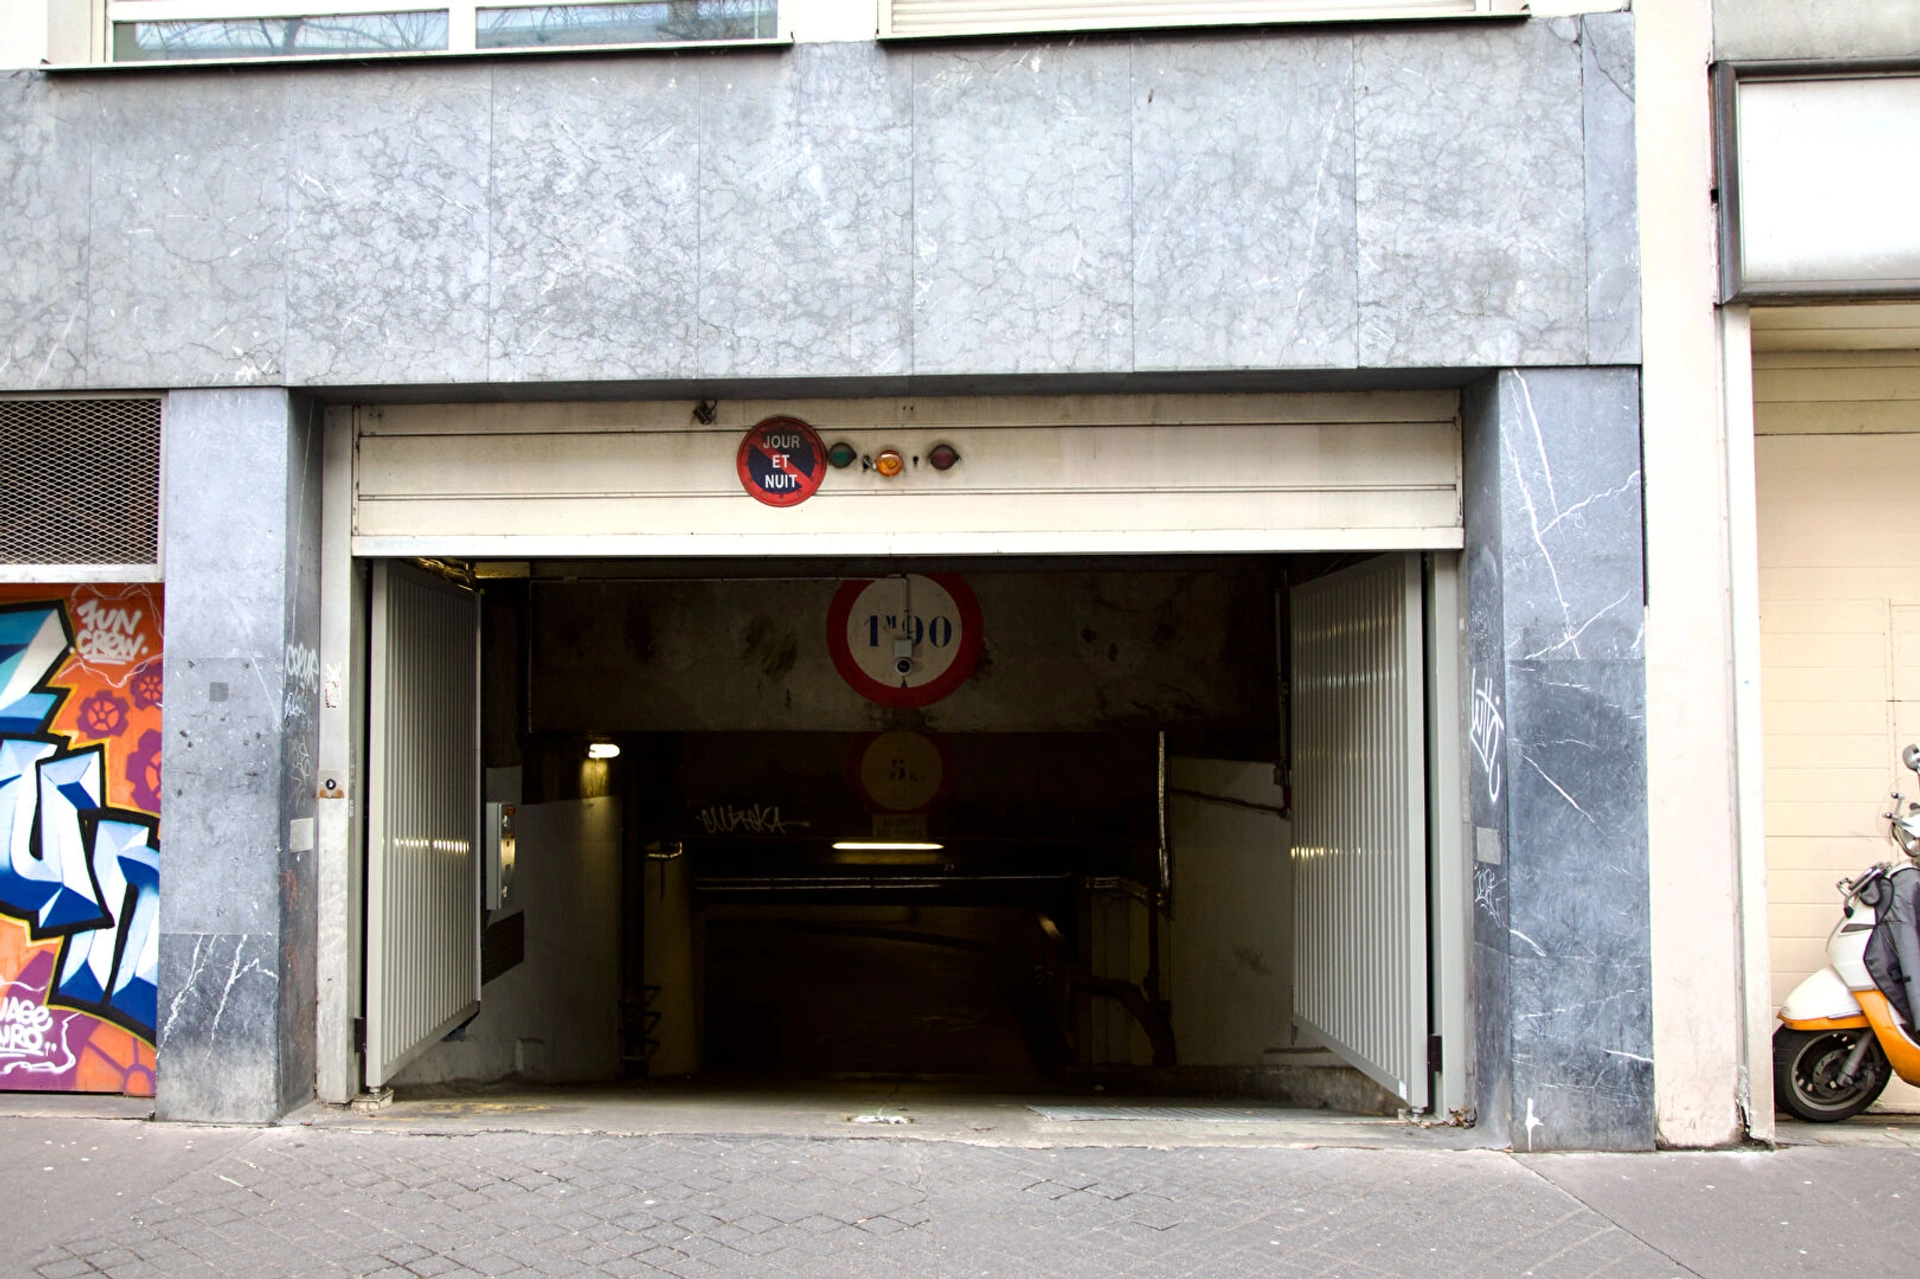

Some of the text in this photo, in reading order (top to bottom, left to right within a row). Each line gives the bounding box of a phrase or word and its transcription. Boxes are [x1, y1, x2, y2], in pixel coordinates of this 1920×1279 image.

[763, 435, 800, 449] JOUR
[772, 454, 790, 468] ET
[764, 474, 798, 489] NUIT
